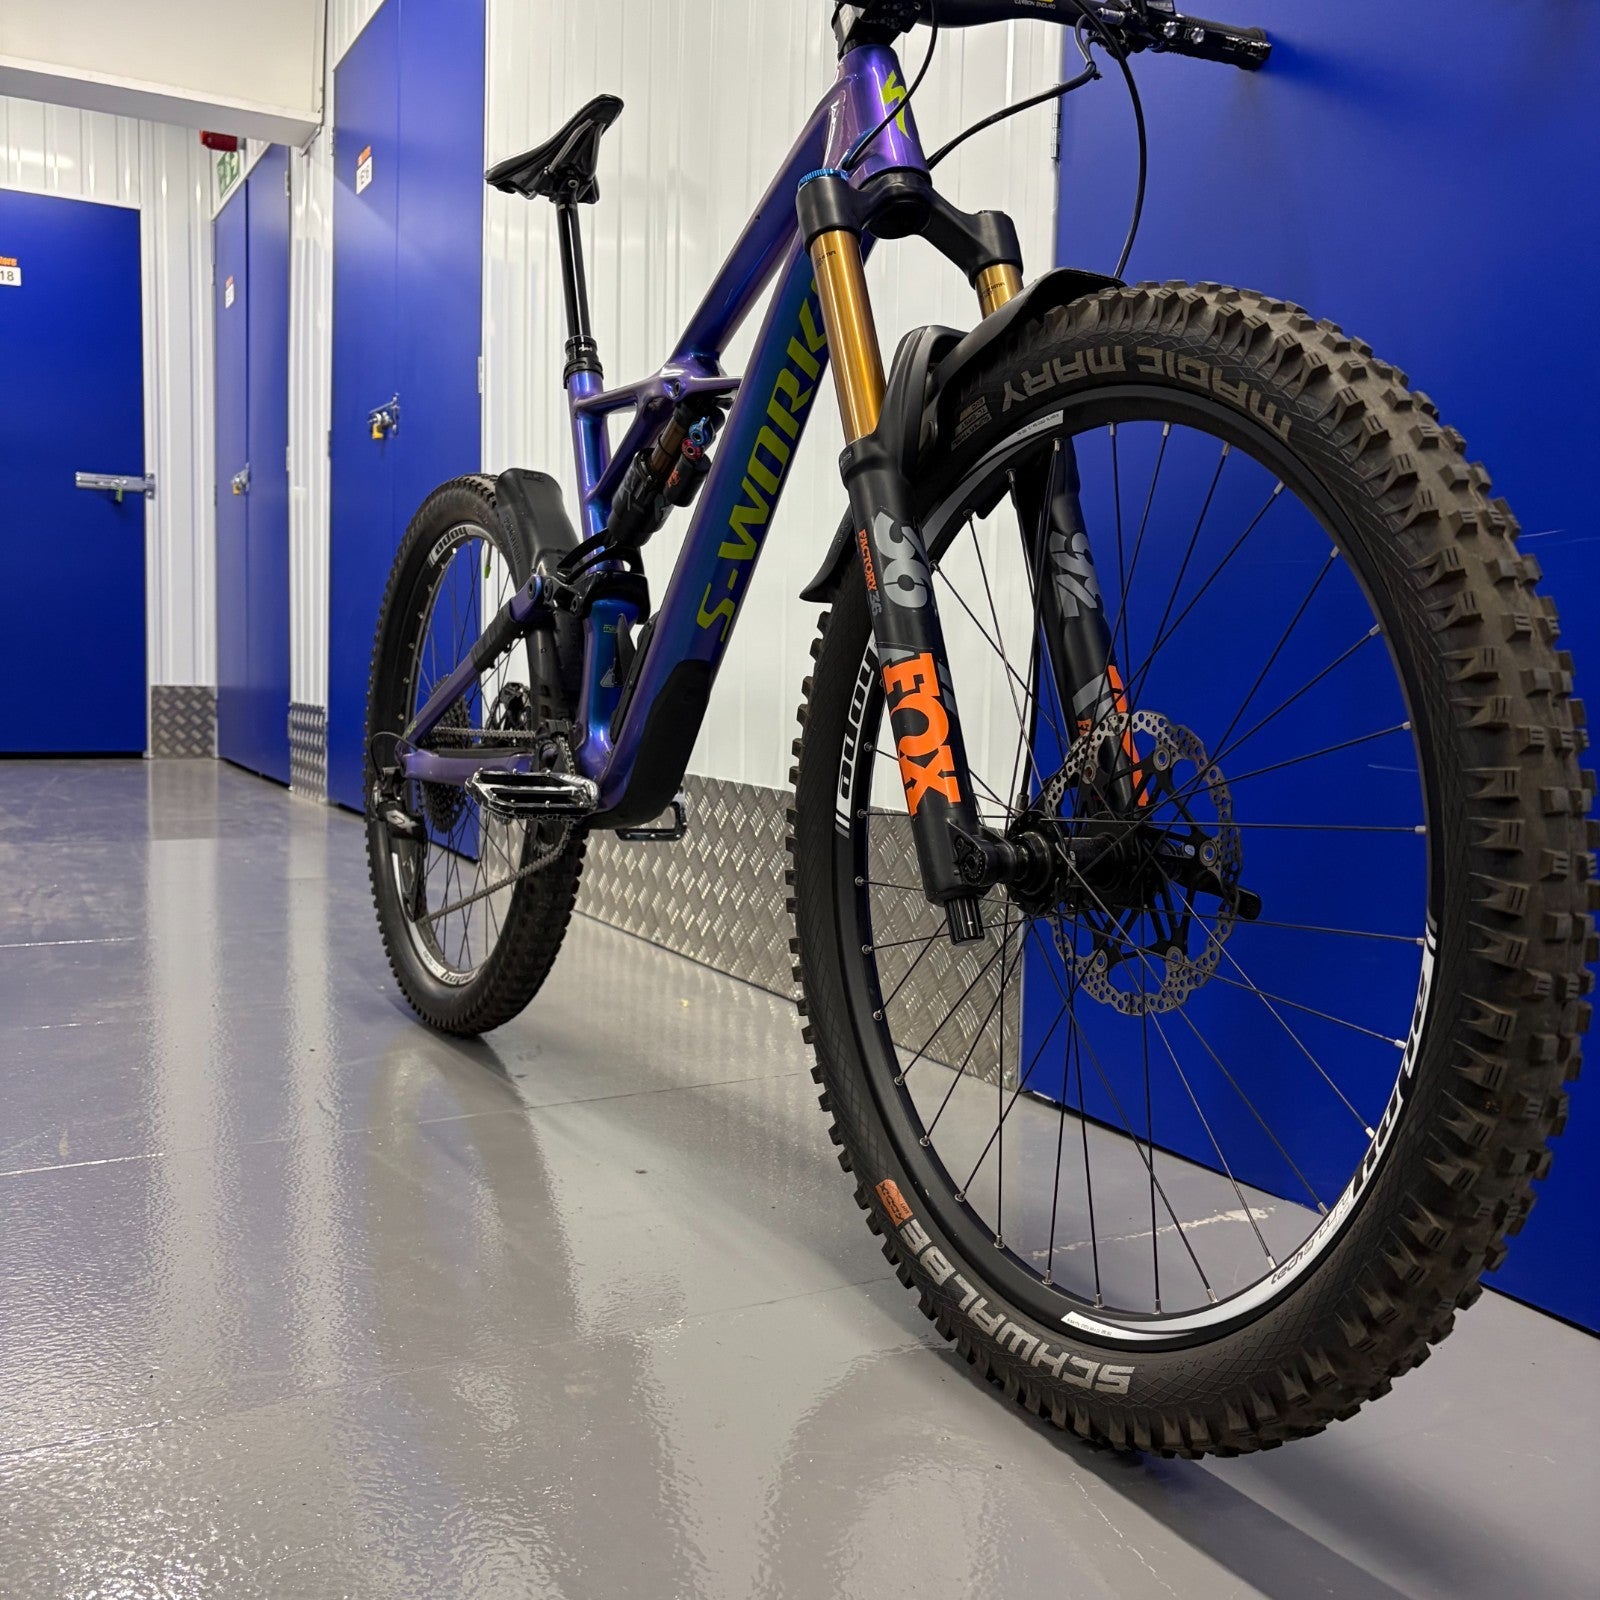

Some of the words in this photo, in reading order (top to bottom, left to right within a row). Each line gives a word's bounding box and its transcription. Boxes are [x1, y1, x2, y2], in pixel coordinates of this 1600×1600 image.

[1001, 346, 1127, 413] MARY
[1136, 346, 1292, 442] MAGIC
[697, 278, 828, 642] S-WORK
[858, 529, 877, 592] FACTORY
[868, 590, 883, 617] 36
[840, 650, 880, 800] hope
[882, 652, 961, 816] FOX
[899, 1219, 1136, 1394] SCHWALBE
